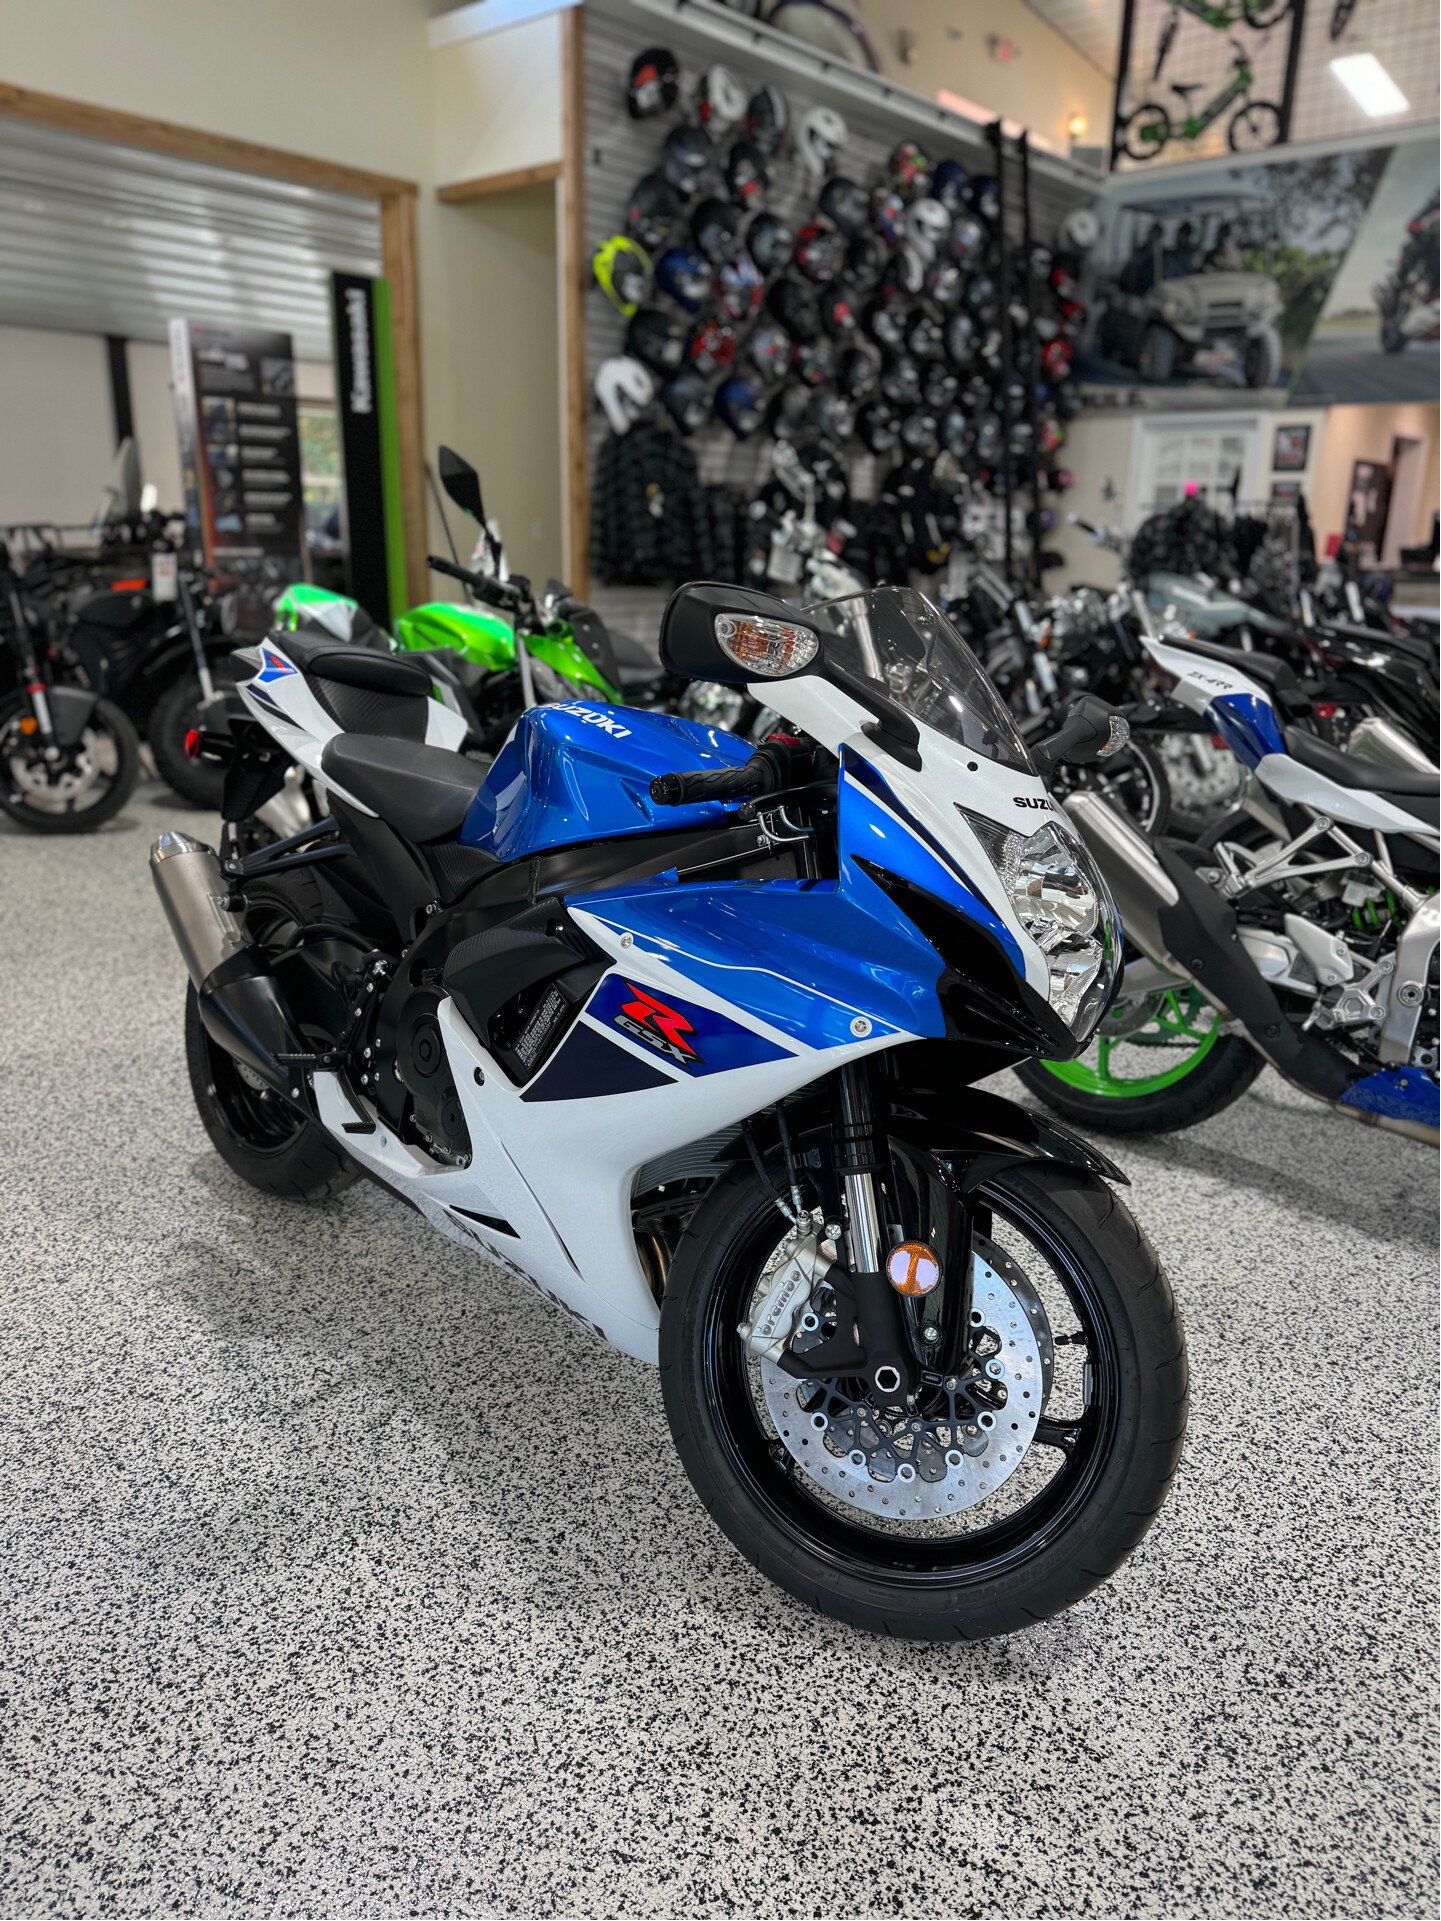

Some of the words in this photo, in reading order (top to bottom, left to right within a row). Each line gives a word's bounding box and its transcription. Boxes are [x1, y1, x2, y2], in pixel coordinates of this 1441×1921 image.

[1012, 796, 1056, 812] SUZU
[613, 1014, 697, 1065] GSX
[761, 1269, 802, 1337] brembo
